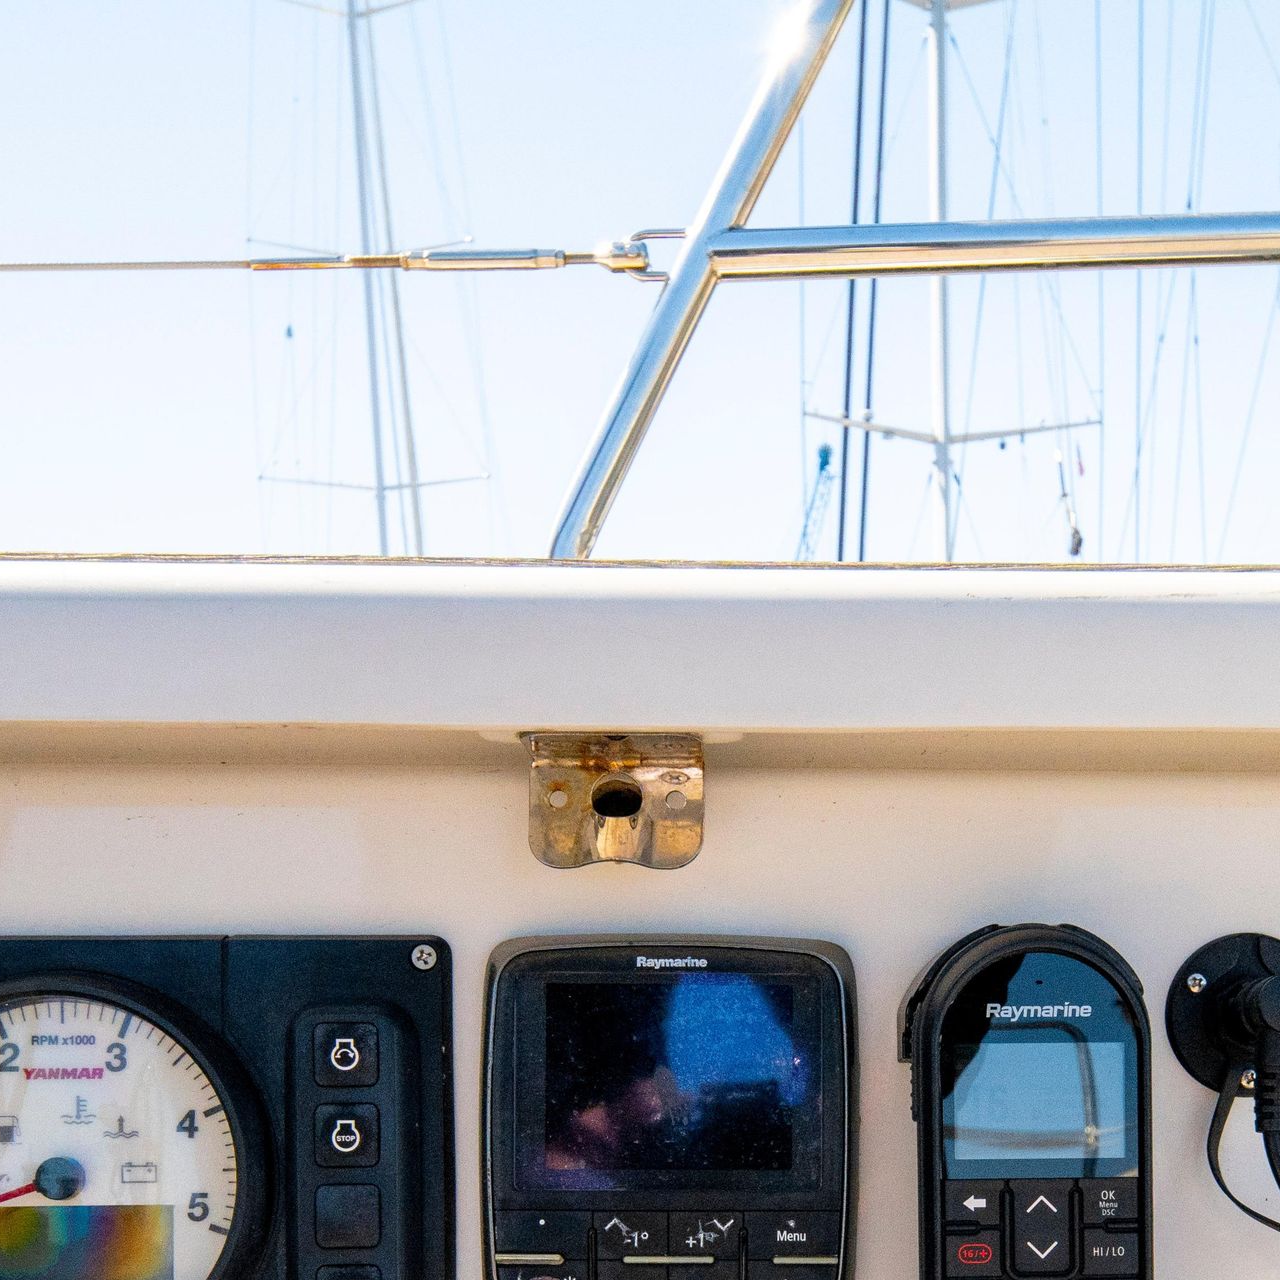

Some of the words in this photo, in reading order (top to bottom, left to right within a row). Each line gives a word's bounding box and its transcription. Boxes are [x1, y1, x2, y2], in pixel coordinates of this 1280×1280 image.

[636, 956, 708, 970] Raymarine
[986, 1002, 1092, 1022] Raymarine
[31, 1035, 59, 1046] RPM
[62, 1034, 96, 1046] x1000
[105, 1042, 128, 1073] 3
[23, 1067, 105, 1080] YANMAR
[176, 1109, 199, 1139] 4
[1101, 1190, 1115, 1200] OK
[187, 1192, 210, 1222] 5
[777, 1230, 807, 1242] Menu
